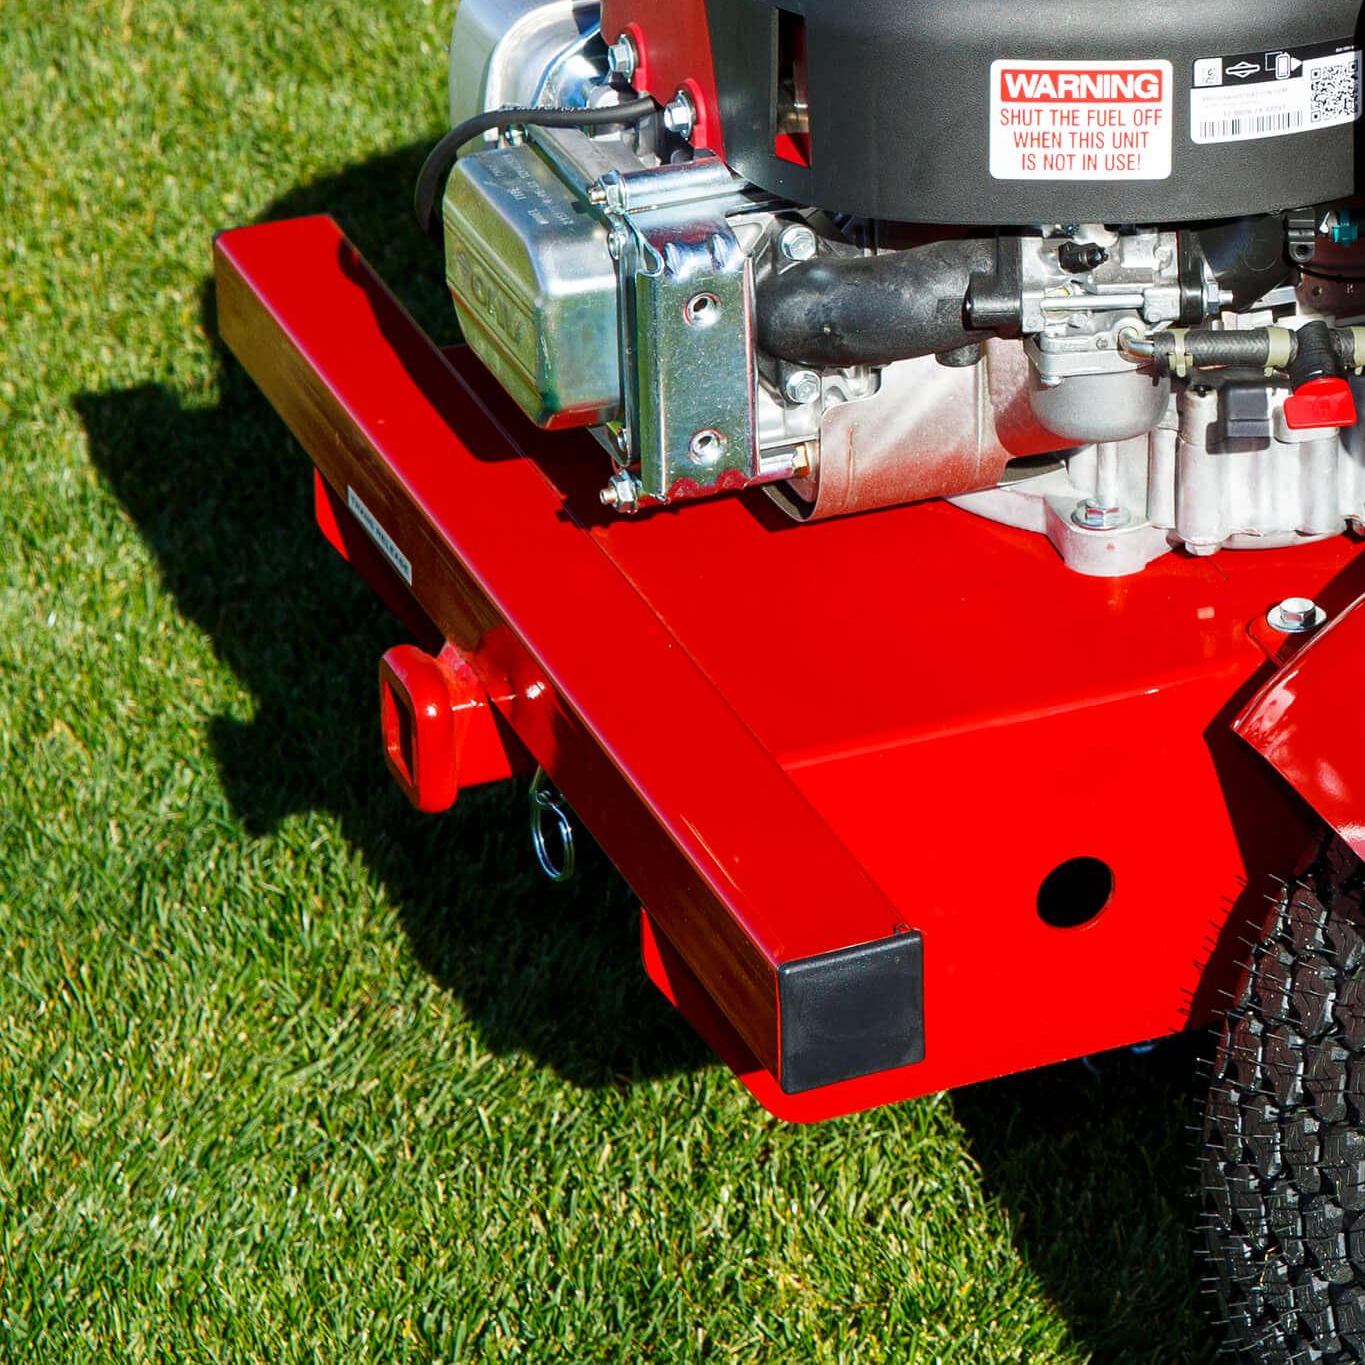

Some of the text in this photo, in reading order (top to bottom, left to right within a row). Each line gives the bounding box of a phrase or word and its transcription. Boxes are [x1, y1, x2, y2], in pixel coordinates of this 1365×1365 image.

[1005, 73, 1159, 99] WARNING
[1000, 109, 1163, 126] SHUT THE FUEL OFF
[1014, 132, 1149, 149] WHEN THIS UNIT
[1022, 154, 1141, 170] IS NOT IN USE!
